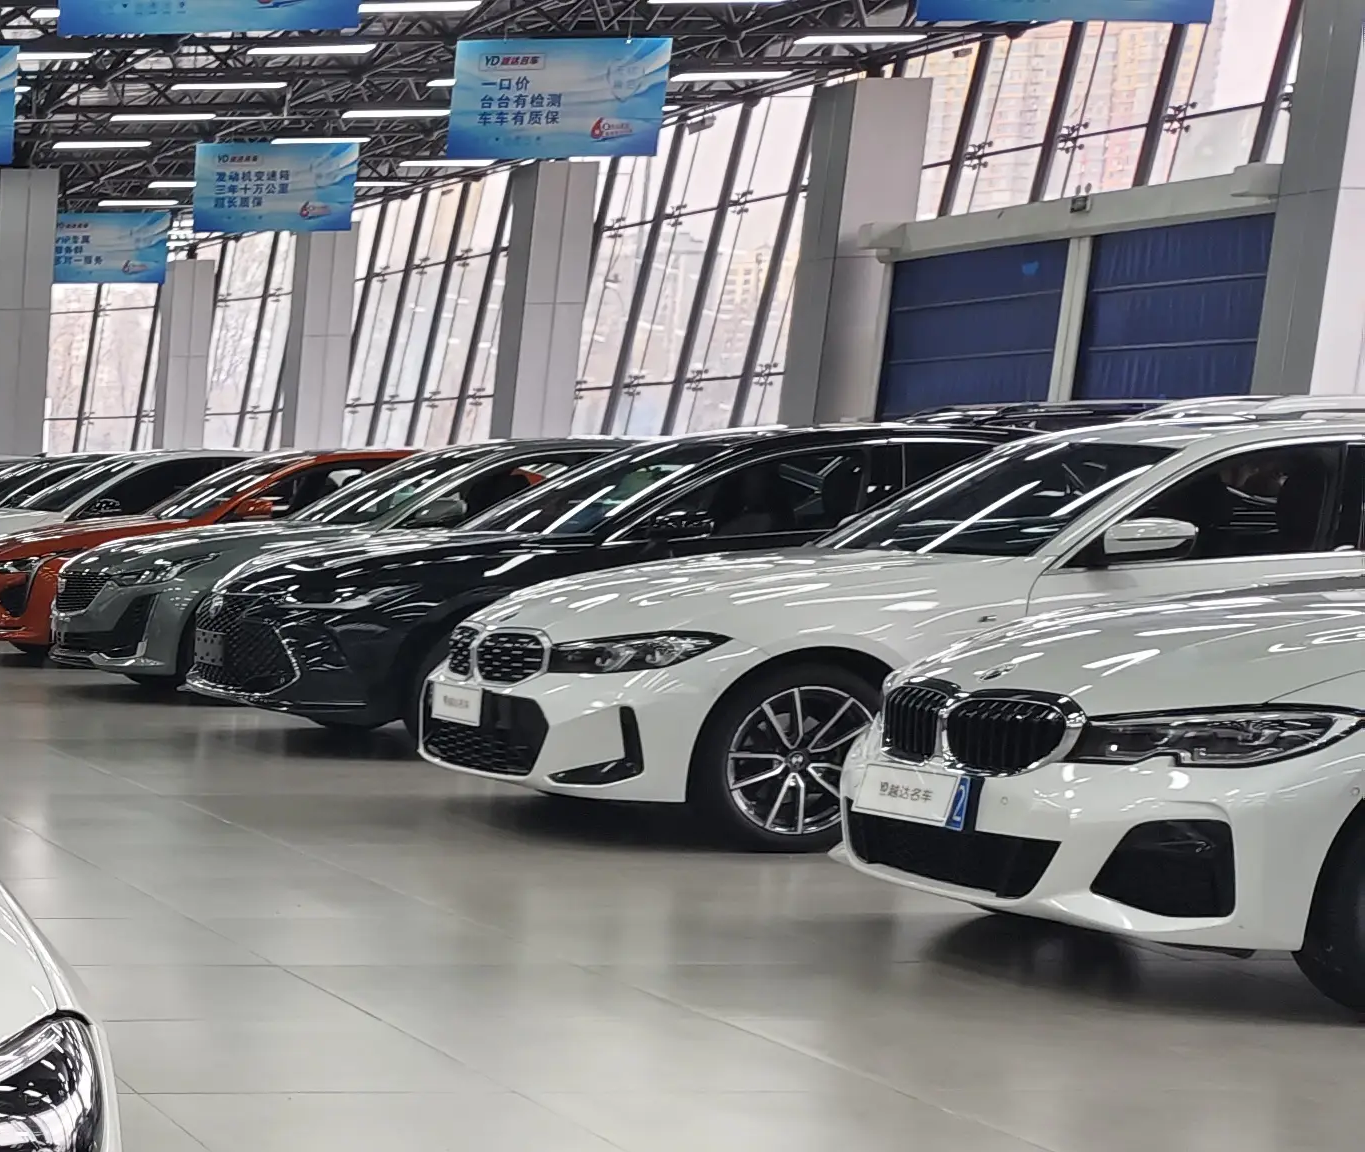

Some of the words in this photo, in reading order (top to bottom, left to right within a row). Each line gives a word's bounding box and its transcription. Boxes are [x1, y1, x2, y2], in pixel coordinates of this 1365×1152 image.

[481, 76, 530, 91] 一口价
[480, 93, 562, 109] 台台有检测
[477, 110, 560, 126] 车车有质保
[214, 183, 289, 194] 三年十万公里
